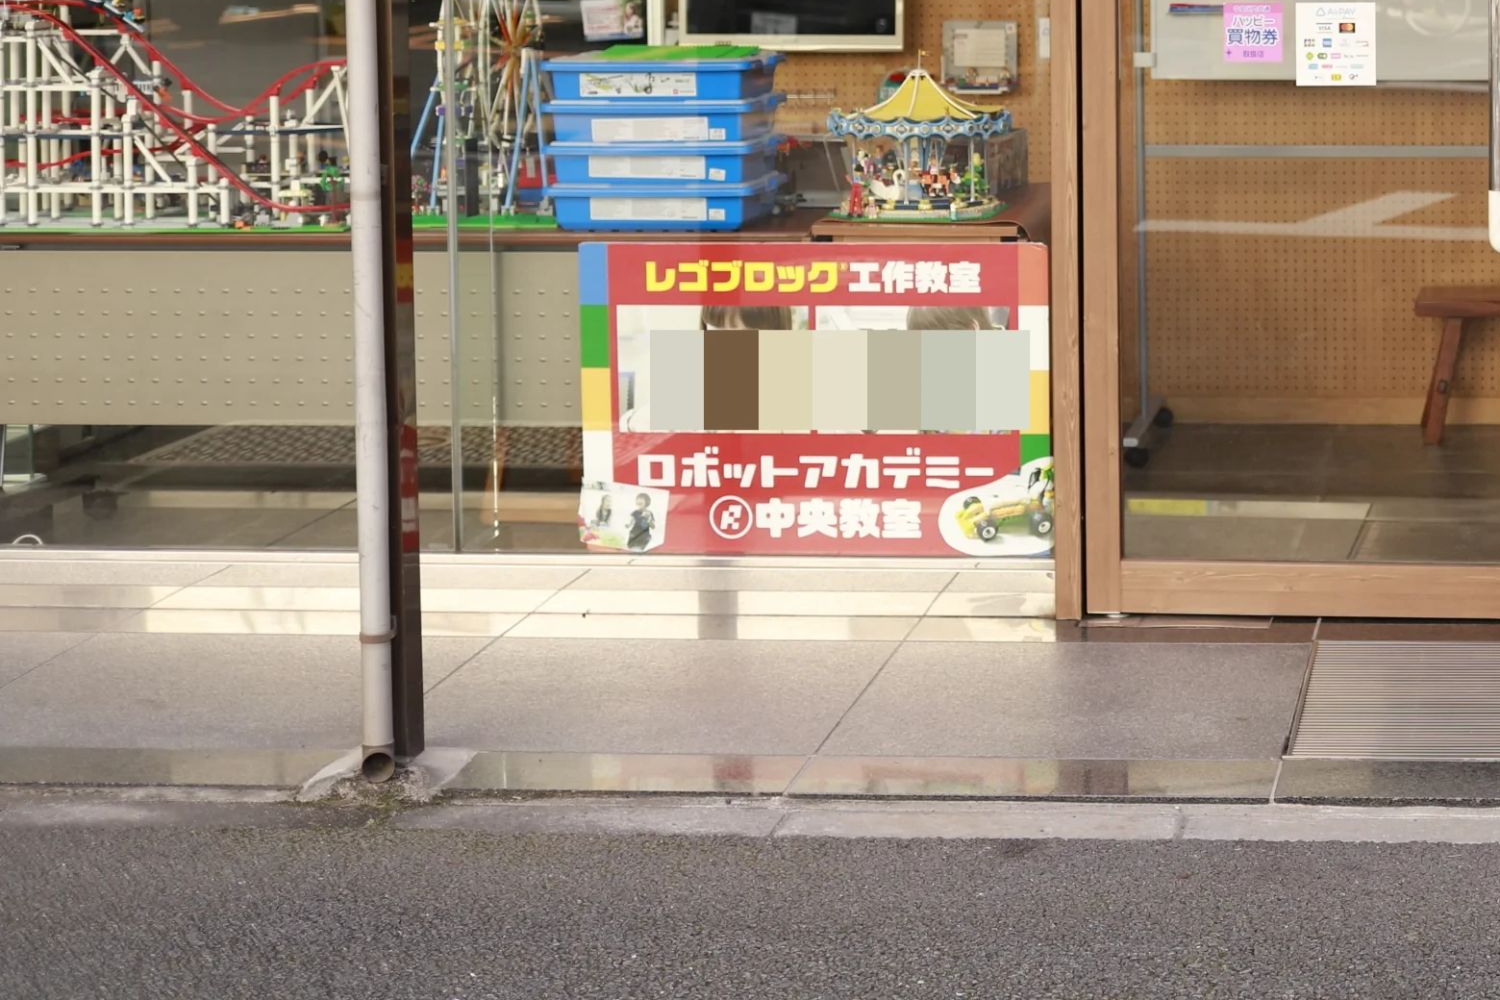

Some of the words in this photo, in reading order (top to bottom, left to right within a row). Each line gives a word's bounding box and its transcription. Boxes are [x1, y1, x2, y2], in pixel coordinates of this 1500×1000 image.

[1227, 28, 1278, 45] 買物券
[637, 446, 994, 490] ロボットアカデミー
[755, 499, 922, 540] 中央教室
